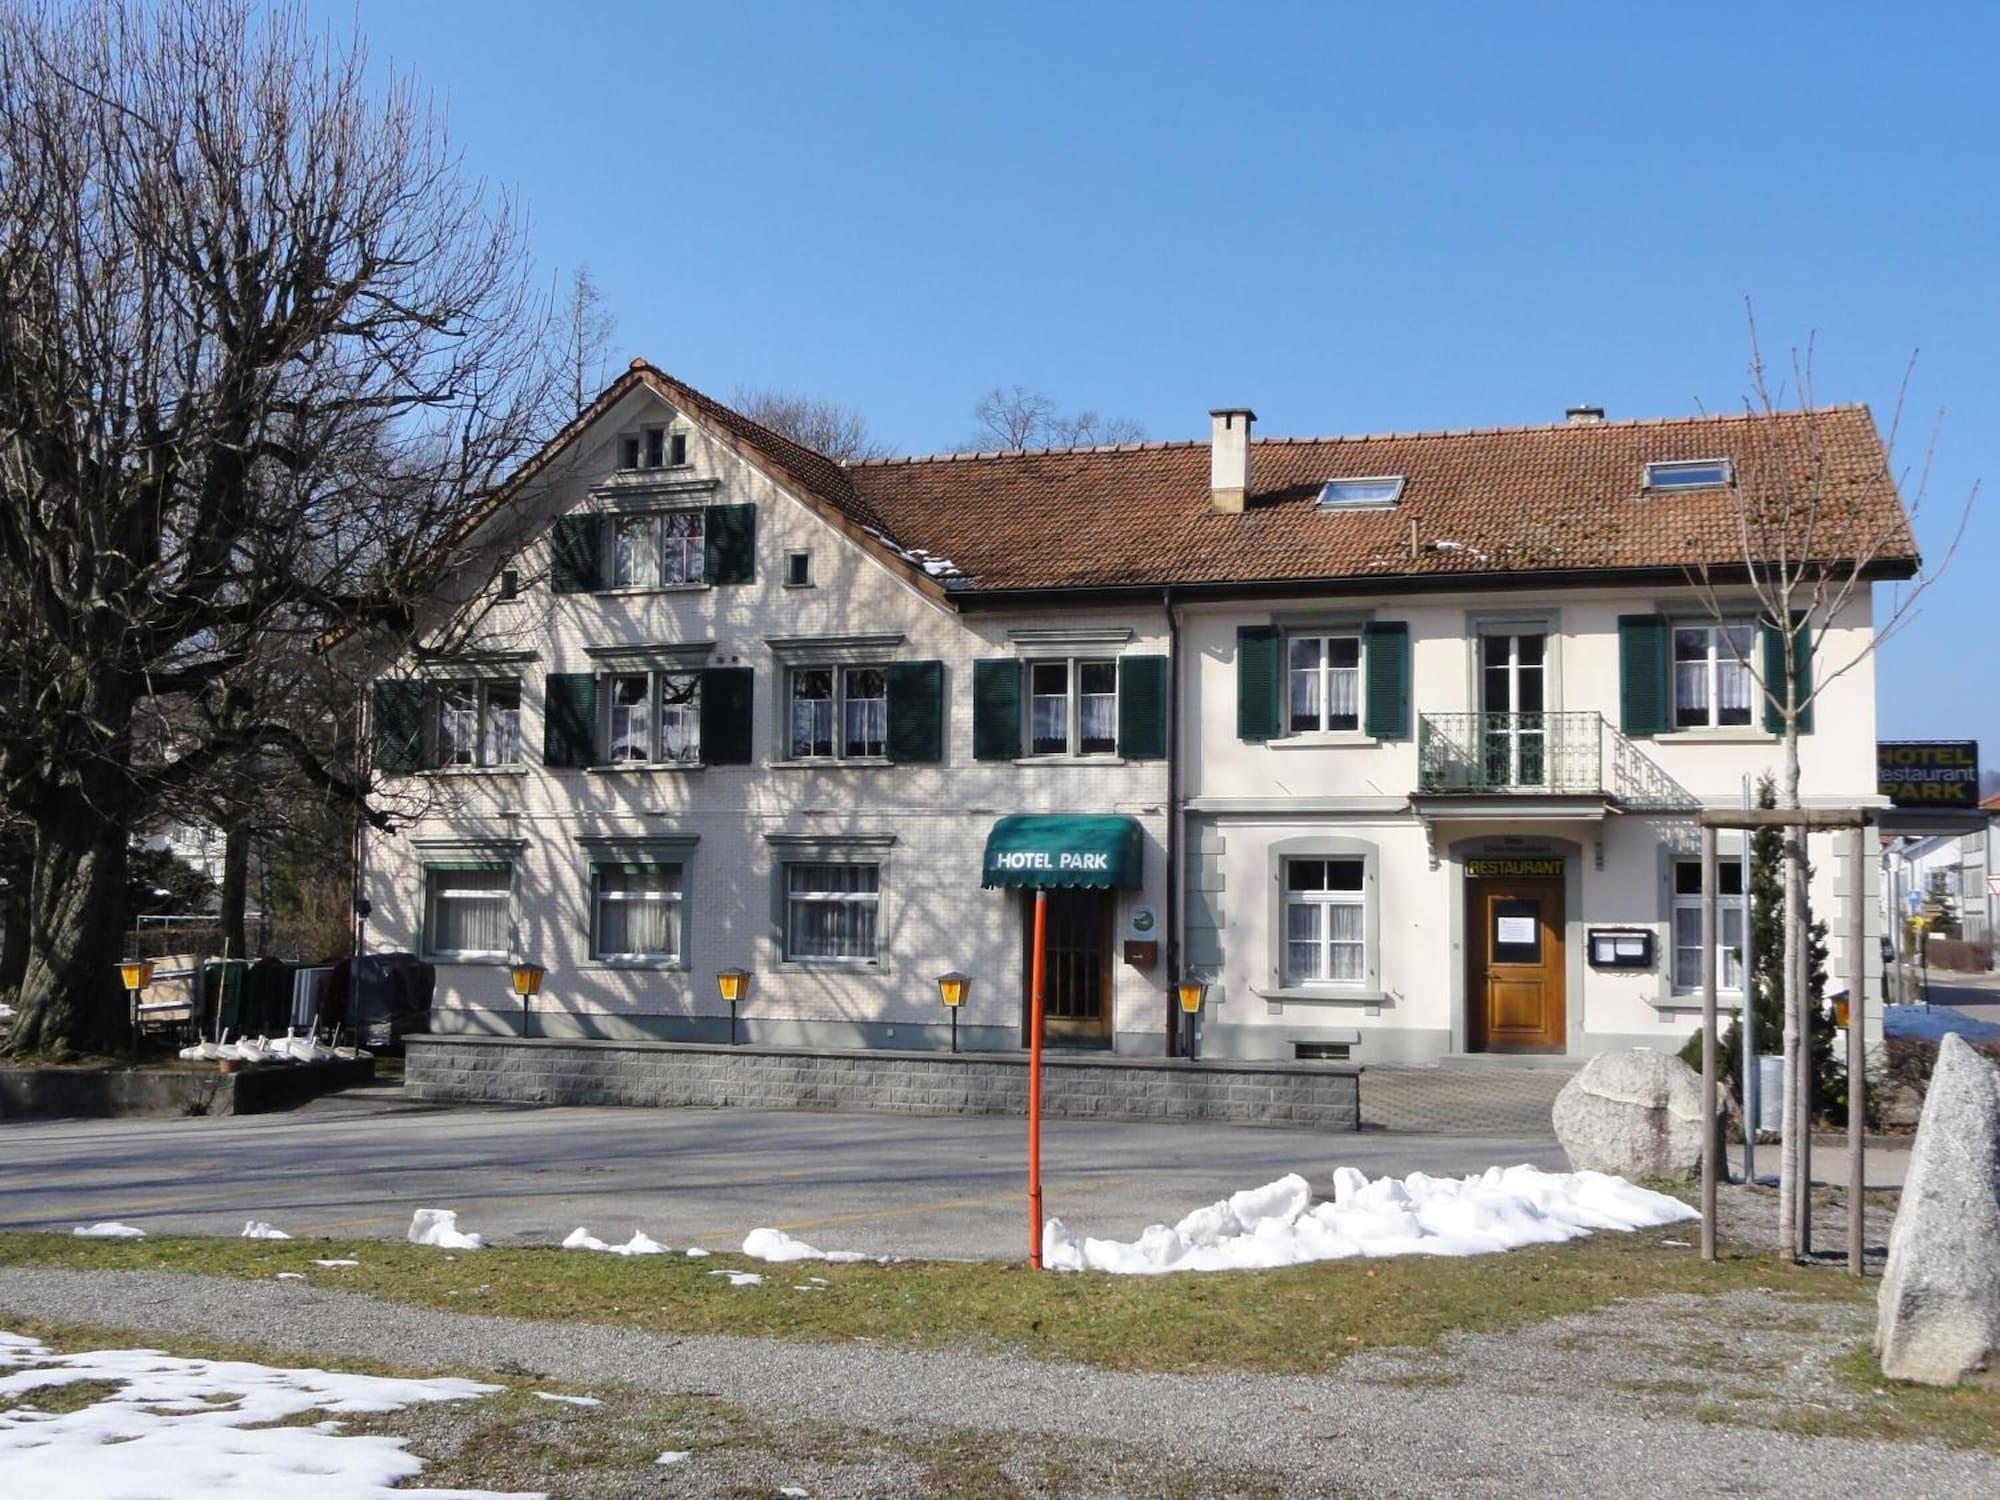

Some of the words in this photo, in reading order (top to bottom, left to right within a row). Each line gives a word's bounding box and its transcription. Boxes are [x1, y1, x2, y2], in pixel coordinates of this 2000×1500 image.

[1879, 767, 1977, 782] estaurant
[1877, 783, 1967, 799] PARK
[997, 852, 1053, 869] HOTEL
[1060, 852, 1108, 869] PARK
[1468, 860, 1563, 874] RESTAURANT
